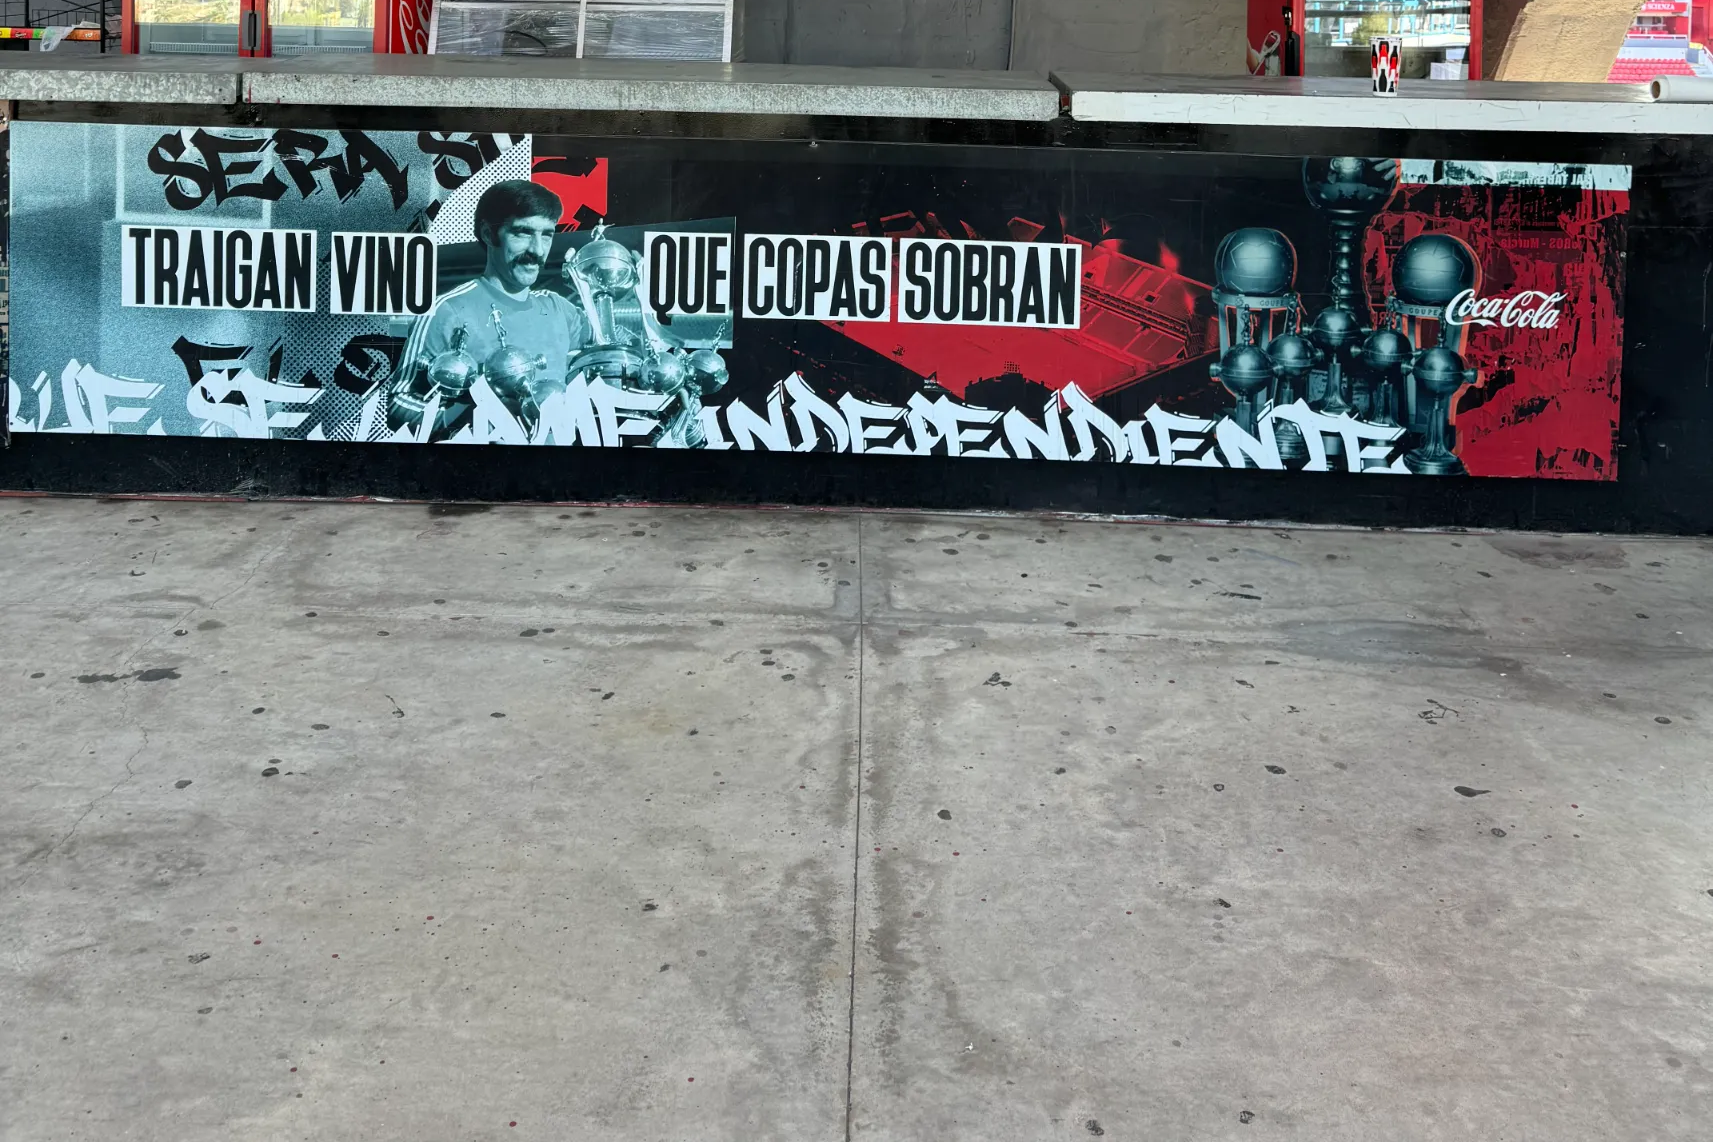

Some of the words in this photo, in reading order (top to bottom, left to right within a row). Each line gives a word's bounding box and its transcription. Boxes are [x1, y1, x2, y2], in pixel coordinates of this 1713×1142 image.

[129, 228, 312, 311] TRAIGAN
[334, 234, 433, 315] VINO
[648, 234, 730, 325] QUE
[748, 237, 887, 318] COPAS
[905, 242, 1077, 325] SOBRAN
[1408, 308, 1438, 317] COUPE
[1445, 288, 1568, 329] Coca-Cola
